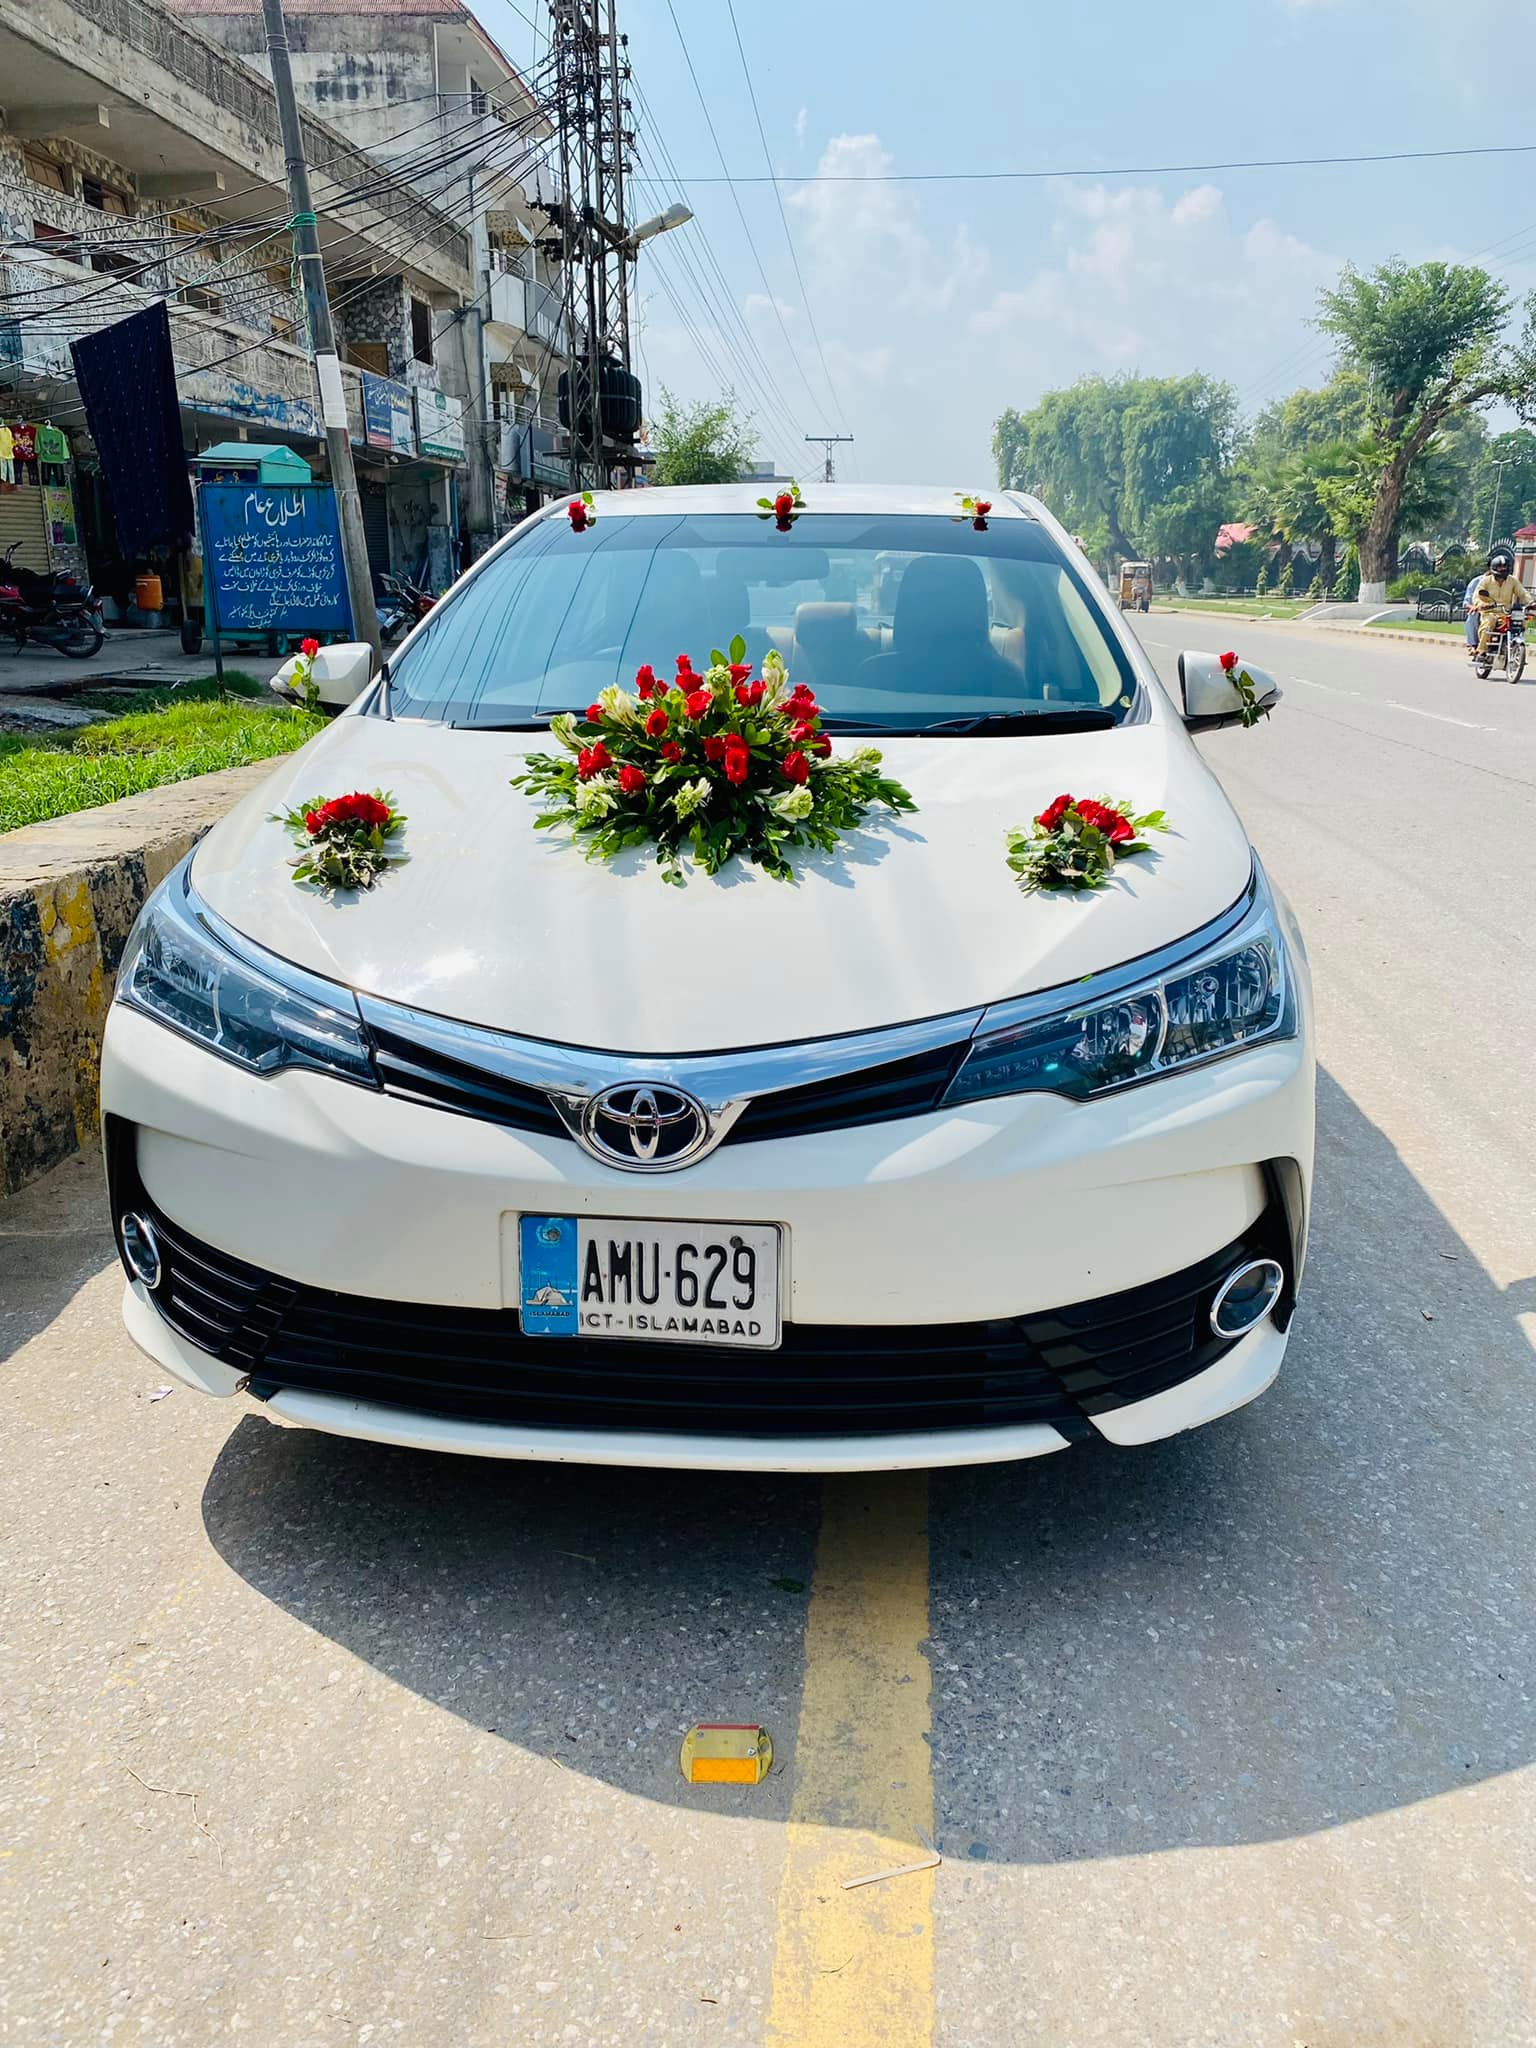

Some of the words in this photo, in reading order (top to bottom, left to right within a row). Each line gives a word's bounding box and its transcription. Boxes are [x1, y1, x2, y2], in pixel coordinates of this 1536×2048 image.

[244, 490, 268, 526] عام
[265, 493, 306, 527] اطلاع
[214, 540, 225, 550] ہے
[218, 553, 229, 562] سے
[243, 552, 257, 563] میں
[220, 580, 240, 591] سخت
[237, 579, 258, 593] خلاف
[256, 579, 265, 592] کے
[306, 582, 322, 593] خلاف
[299, 594, 311, 608] میں
[580, 1311, 762, 1337] ICT-ISLAMABAD
